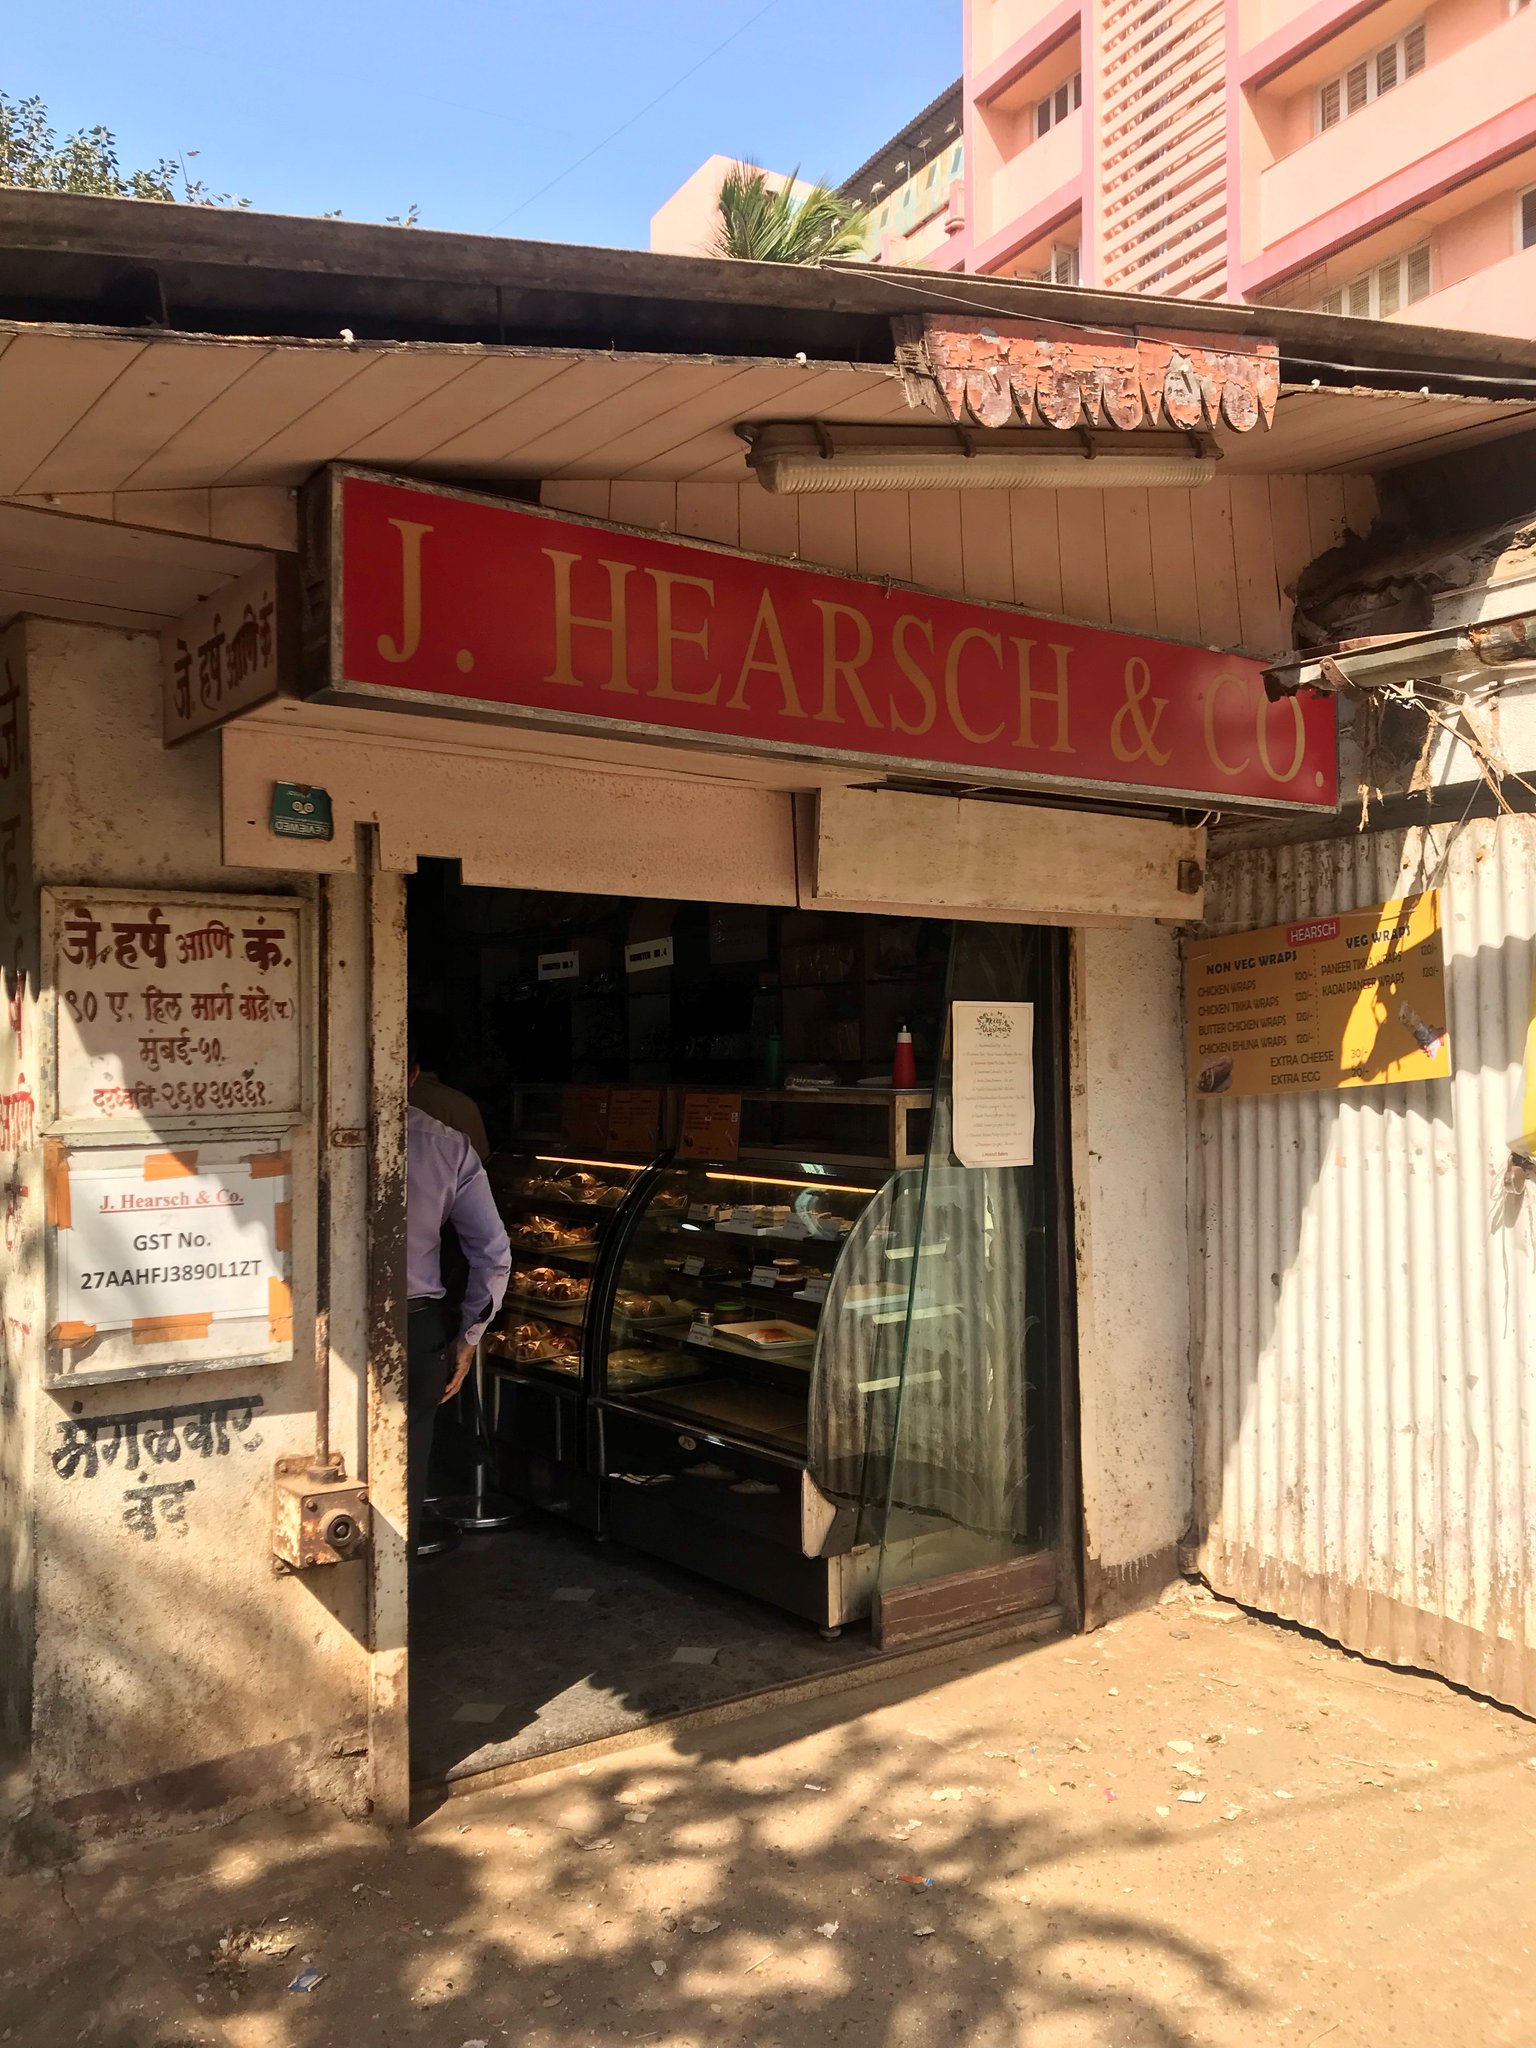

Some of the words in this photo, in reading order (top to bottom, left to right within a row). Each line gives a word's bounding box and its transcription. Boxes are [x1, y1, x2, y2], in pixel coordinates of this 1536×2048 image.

[376, 517, 475, 674] J.
[540, 547, 1077, 754] HEARSCH
[1110, 656, 1173, 767] &
[1203, 672, 1325, 788] CO.
[175, 919, 235, 965] आणि
[1290, 921, 1337, 943] HEARSCH
[1345, 934, 1369, 949] VEG
[1371, 925, 1411, 943] WRAPS
[1206, 961, 1231, 975] NON
[1234, 957, 1256, 971] VEG
[1259, 950, 1297, 966] WRAPS
[1321, 960, 1352, 976] PANEER
[1197, 984, 1229, 998] CHICKEN
[1231, 980, 1256, 992] WRAPS
[1322, 982, 1346, 997] KADAI
[1347, 977, 1377, 993] PANEER
[1378, 972, 1404, 987] WRAPS
[140, 984, 183, 1025] हिल
[190, 982, 234, 1021] मार्ग
[1198, 1003, 1230, 1017] CHICKEN
[1231, 1000, 1252, 1012] TIKKA
[1253, 996, 1280, 1009] WRAPS
[1198, 1022, 1226, 1036] BUTTER
[1227, 1019, 1259, 1033] CHICKEN
[1261, 1015, 1286, 1029] WRAPS
[1199, 1042, 1231, 1055] CHICKEN
[1261, 1035, 1287, 1048] WRAPS
[1270, 1055, 1299, 1068] EXTRA
[1300, 1050, 1334, 1064] CHEESE
[1271, 1072, 1299, 1086] EXTRA
[1301, 1071, 1321, 1083] EGG
[99, 1194, 115, 1211] J.
[121, 1191, 190, 1209] Hearsch
[195, 1190, 210, 1205] &
[217, 1188, 245, 1204] Co.
[133, 1232, 173, 1252] GST
[178, 1231, 212, 1249] No.
[80, 1259, 263, 1291] 27AAHFJ3890L1ZT
